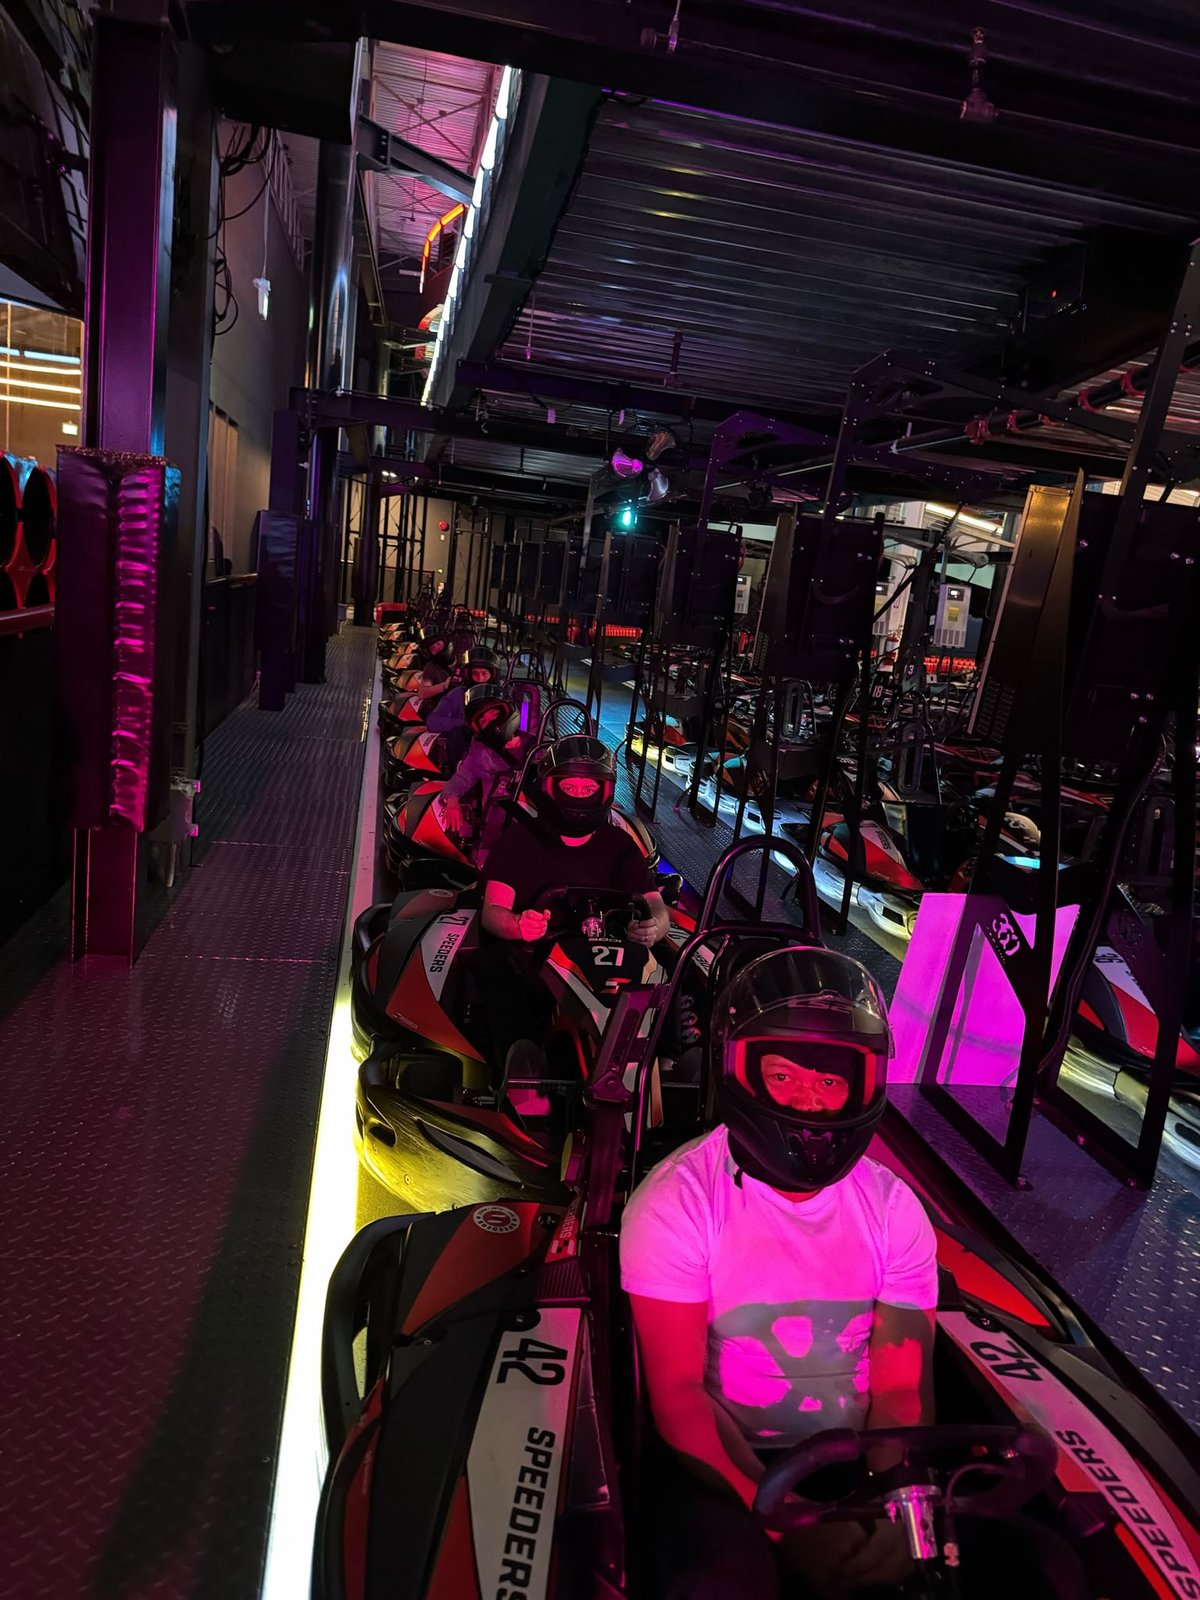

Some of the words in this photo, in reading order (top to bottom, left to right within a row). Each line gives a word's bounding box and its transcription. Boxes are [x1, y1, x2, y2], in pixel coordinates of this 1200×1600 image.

[429, 932, 460, 973] SPEEDERS
[591, 945, 625, 967] 27
[496, 1338, 568, 1386] 42
[969, 1338, 1044, 1381] 42
[496, 1426, 556, 1600] SPEEDERS
[1055, 1429, 1200, 1600] SPEEDERS
